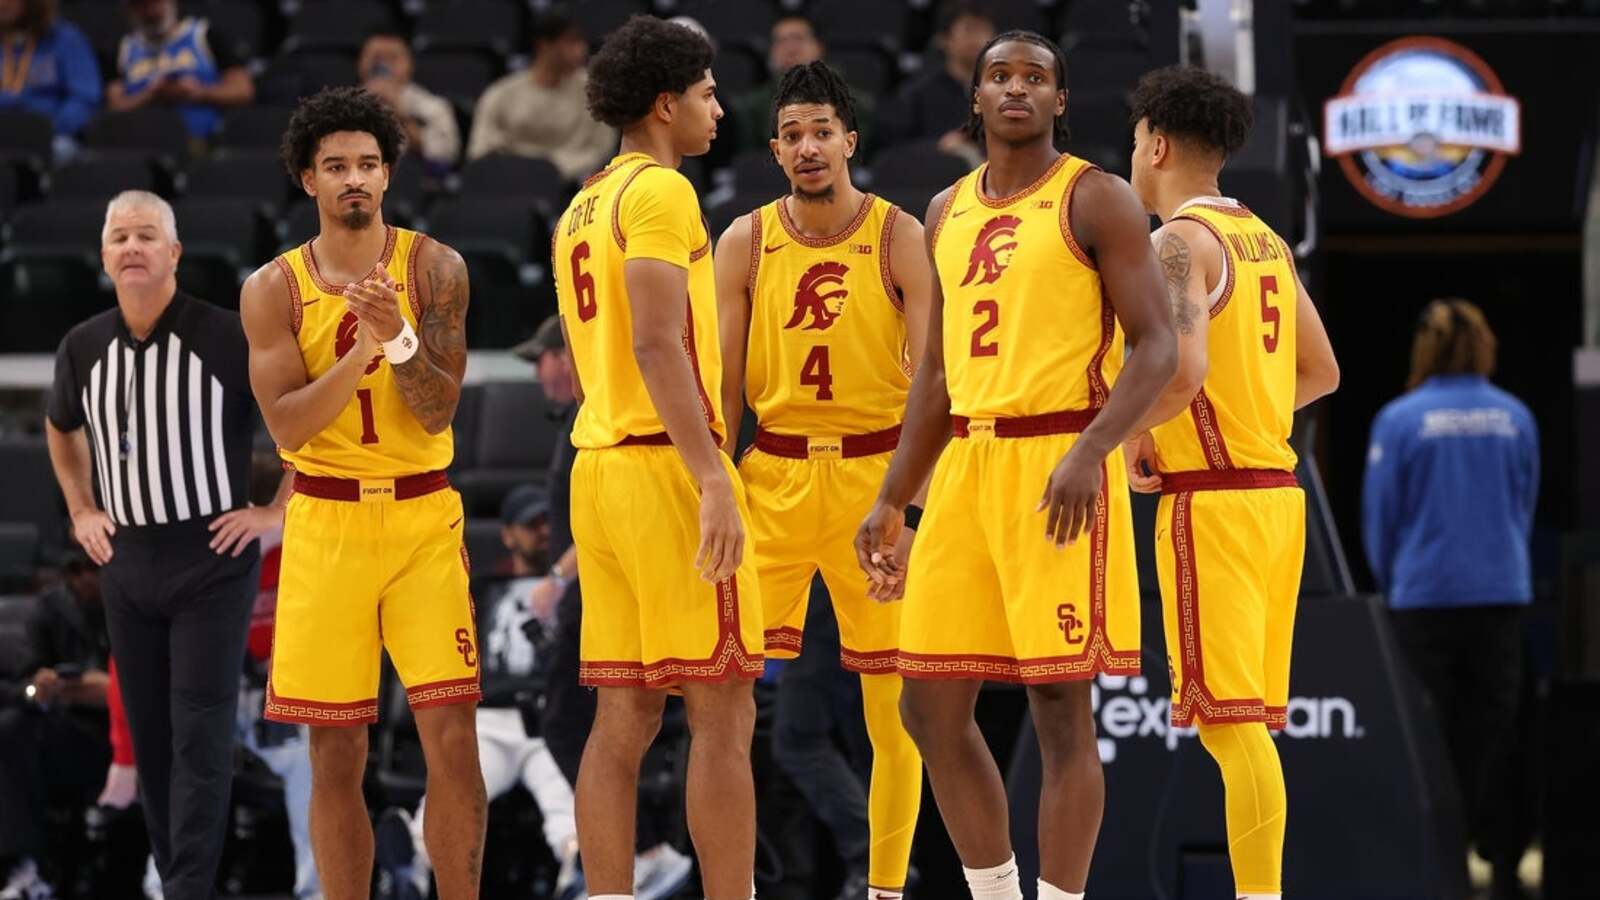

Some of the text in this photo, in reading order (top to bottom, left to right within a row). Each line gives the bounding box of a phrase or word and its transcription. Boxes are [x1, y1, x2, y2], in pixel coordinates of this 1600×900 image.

[570, 240, 597, 323] 6
[970, 299, 999, 358] 2
[1259, 275, 1280, 353] 5
[800, 345, 833, 400] 4
[356, 389, 379, 445] 1
[362, 487, 381, 495] FIGHT
[455, 627, 476, 668] SC
[1057, 603, 1083, 645] SC
